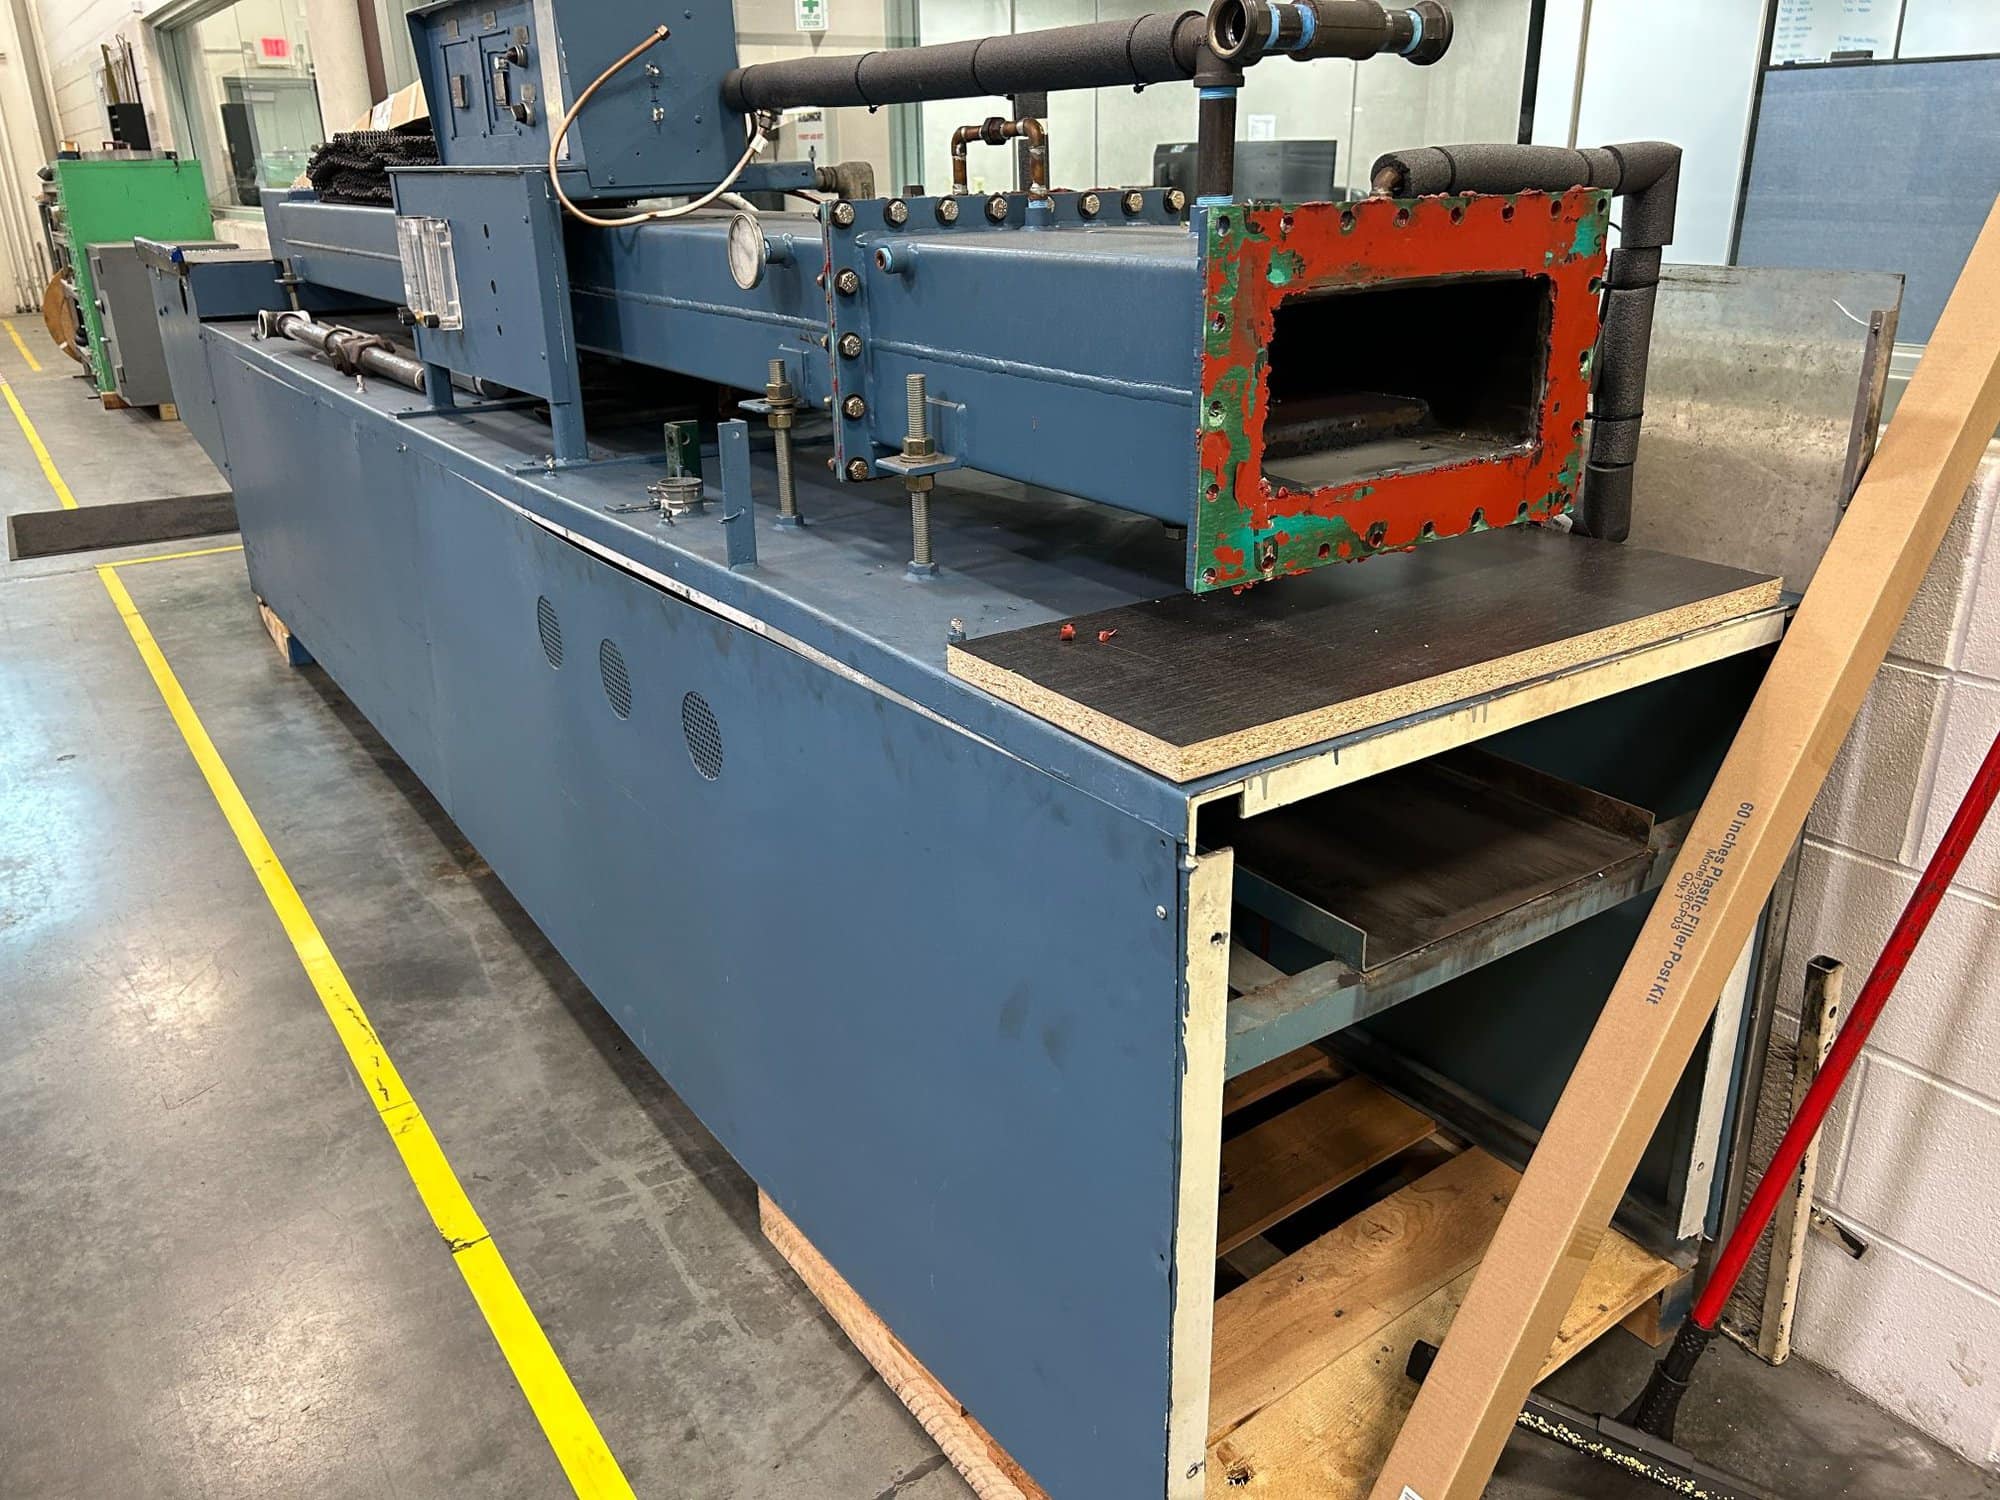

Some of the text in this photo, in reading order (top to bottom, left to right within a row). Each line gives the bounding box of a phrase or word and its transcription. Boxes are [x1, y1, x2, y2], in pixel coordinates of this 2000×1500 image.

[1646, 802, 1754, 1005] 60 inches Plastic Filler Post Kit
[1670, 849, 1717, 930] Model 238CP03
